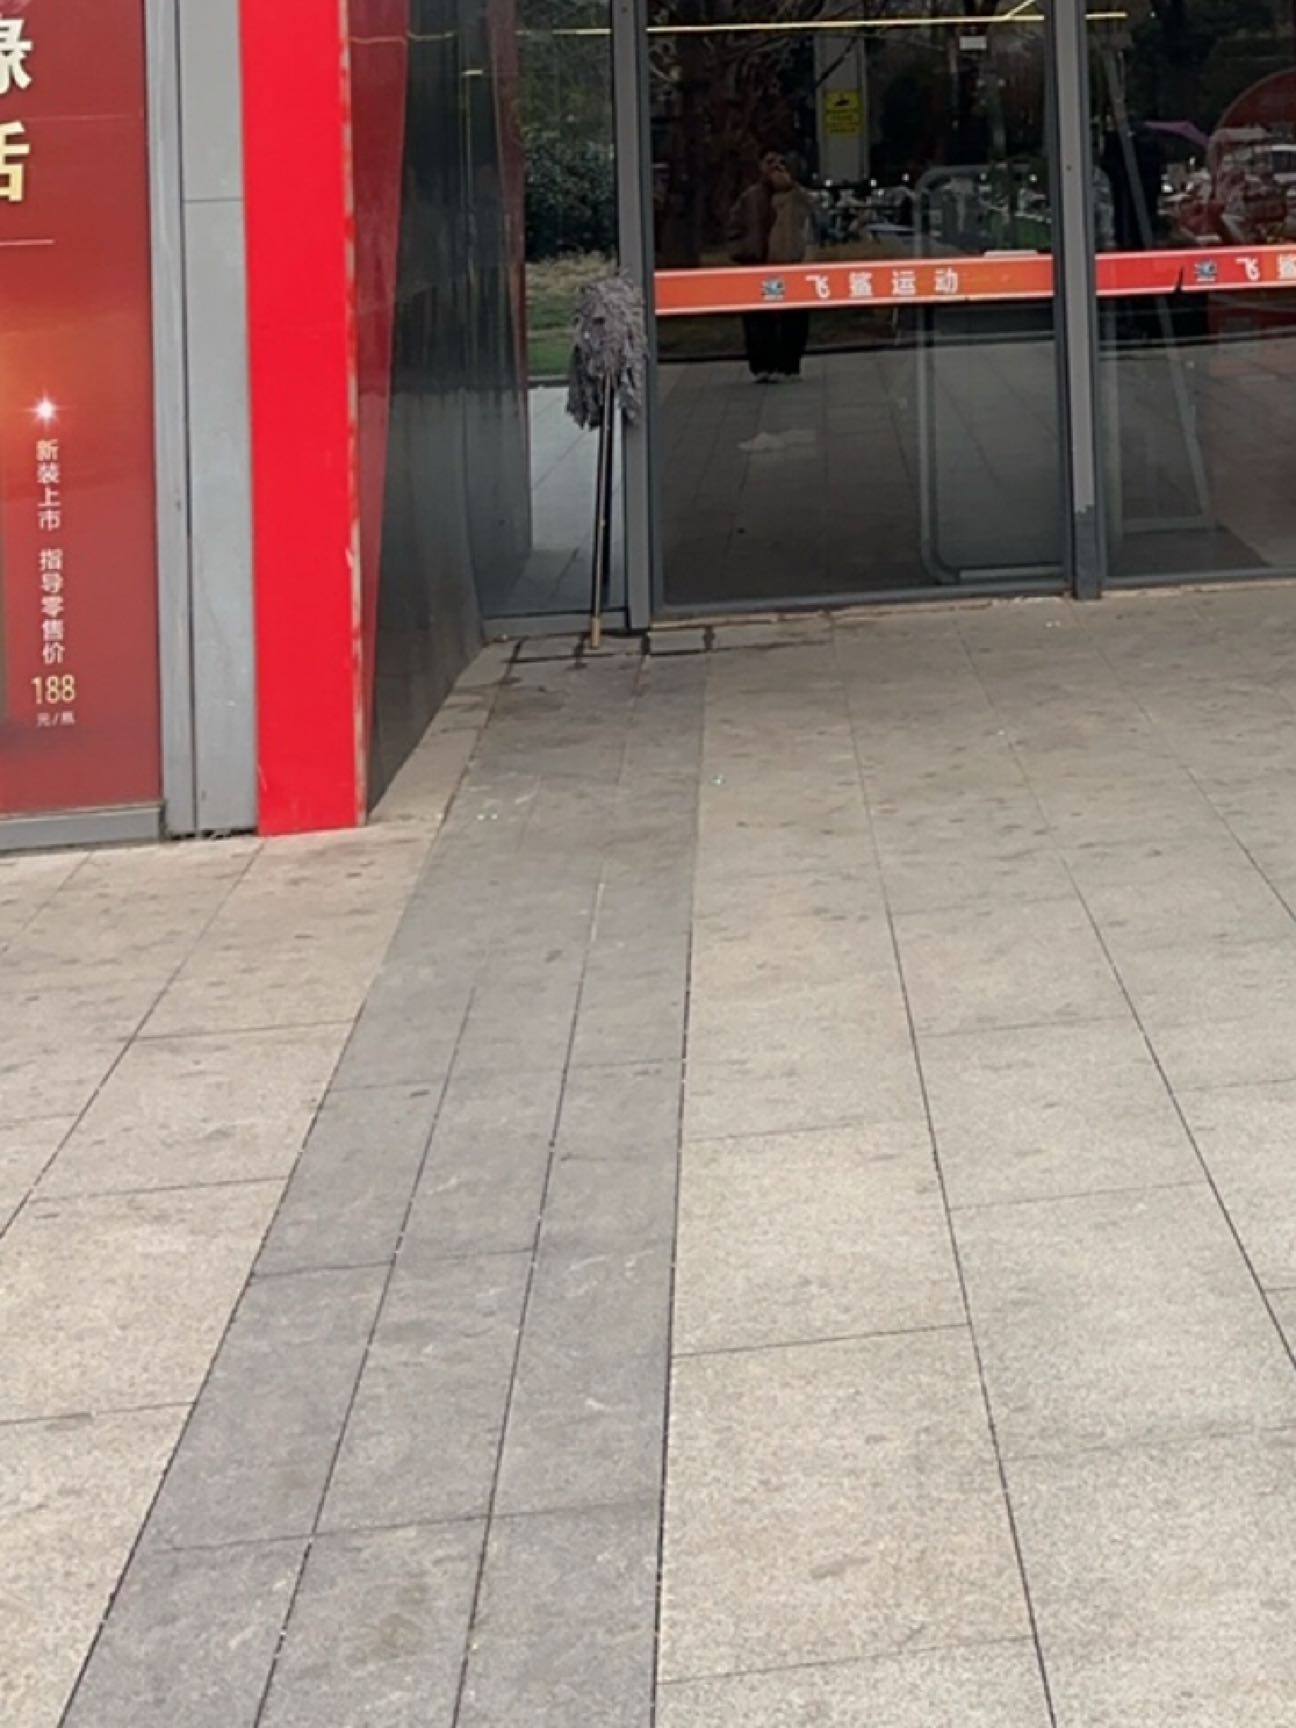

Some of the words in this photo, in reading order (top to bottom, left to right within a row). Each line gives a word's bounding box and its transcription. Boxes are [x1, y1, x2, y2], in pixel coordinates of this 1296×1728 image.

[804, 267, 959, 300] 飞鲨运动
[36, 438, 62, 530] 新装上市
[38, 548, 66, 665] 指导零售价
[31, 674, 76, 705] 188
